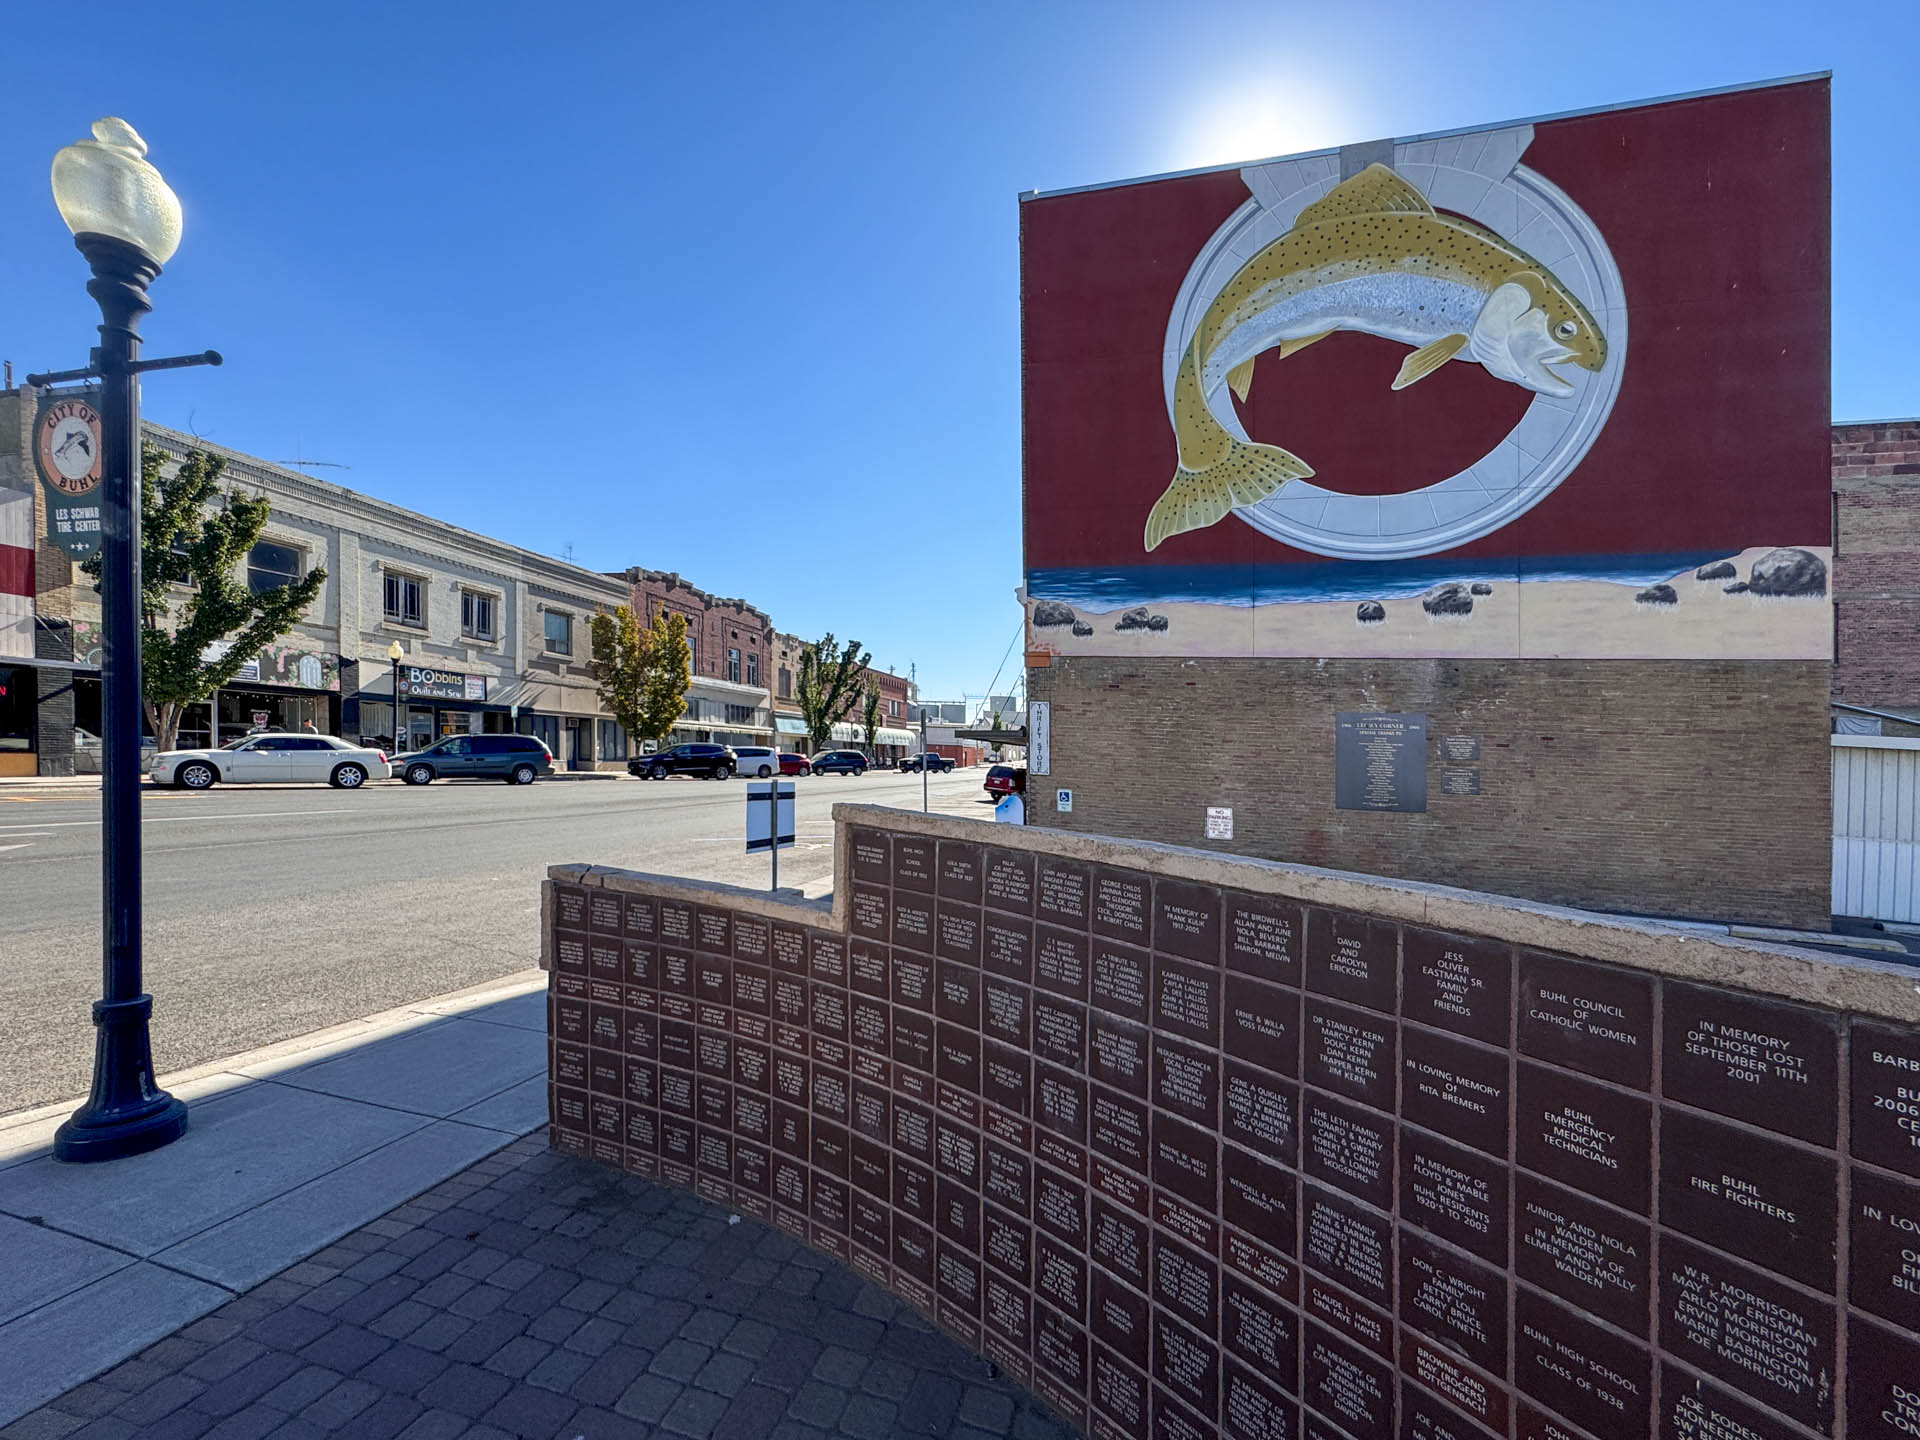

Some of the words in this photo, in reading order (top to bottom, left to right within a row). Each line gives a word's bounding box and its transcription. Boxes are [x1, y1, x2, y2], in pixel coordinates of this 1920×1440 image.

[48, 404, 75, 428] CITY
[78, 407, 97, 425] OF
[59, 474, 98, 492] BUHL
[56, 508, 68, 520] LES
[71, 507, 100, 519] SCHWAB
[56, 521, 72, 532] TIRE
[75, 520, 100, 532] CENTER
[1337, 937, 1361, 948] DAVID
[1340, 947, 1358, 957] AND
[1444, 951, 1463, 962] JESS
[1330, 962, 1367, 978] ERICKSON
[1331, 954, 1367, 969] CAROLYN
[1422, 966, 1466, 984] EASTMAN
[1437, 959, 1469, 974] OLIVER
[1436, 979, 1468, 994] FAMILY
[1442, 991, 1463, 1003] AND
[1433, 999, 1470, 1016] FRIENDS
[1540, 989, 1568, 1004] BUHL
[1573, 997, 1624, 1018] COUNCIL
[1573, 1009, 1588, 1019] OF
[1313, 1015, 1323, 1024] DR
[1326, 1019, 1359, 1035] STANLEY
[1362, 1030, 1383, 1043] KERN
[1321, 1027, 1349, 1041] MARCY
[1352, 1037, 1374, 1049] KERN
[1530, 1009, 1583, 1030] CATHOLIC
[1588, 1024, 1636, 1044] WOMEN
[1700, 1020, 1713, 1032] IN
[1721, 1025, 1789, 1050] MEMORY
[1324, 1037, 1346, 1050] DOUG
[1349, 1045, 1371, 1058] KERN
[1326, 1046, 1343, 1058] DAN
[1346, 1054, 1367, 1066] KERN
[1687, 1030, 1705, 1042] OF
[1711, 1036, 1757, 1056] THOSE
[1765, 1050, 1804, 1067] LOST
[1319, 1053, 1351, 1070] TRAPPER
[1355, 1065, 1376, 1079] KERN
[1328, 1066, 1341, 1076] JIM
[1344, 1070, 1365, 1085] KERN
[1685, 1042, 1767, 1072] SEPTEMBER
[1775, 1066, 1807, 1083] 11TH
[1727, 1066, 1759, 1084] 2001
[1406, 1059, 1415, 1068] IN
[1419, 1063, 1452, 1081] LOVING
[1456, 1076, 1500, 1096] MEMORY
[1419, 1083, 1438, 1096] RITA
[1442, 1091, 1485, 1113] BREMERS
[1544, 1111, 1615, 1143] EMERGENCY
[1564, 1107, 1594, 1125] BUHL
[1543, 1133, 1617, 1168] TECHNICIANS
[1553, 1126, 1604, 1152] MEDICAL
[1413, 1163, 1441, 1181] FLOYD
[1456, 1182, 1488, 1202] MABLE
[1415, 1154, 1424, 1164] IN
[1428, 1159, 1470, 1182] MEMORY
[1474, 1179, 1487, 1189] OF
[1722, 1174, 1760, 1197] BUHL
[1413, 1183, 1436, 1200] BUHL
[1440, 1194, 1489, 1223] RESIDENTS
[1691, 1176, 1718, 1194] FIRE
[1725, 1189, 1795, 1222] FIGHTERS
[1447, 1208, 1460, 1219] TO
[1464, 1215, 1487, 1232] 2003
[1526, 1202, 1564, 1225] JUNIOR
[1569, 1221, 1595, 1238] AND
[1601, 1234, 1636, 1256] NOLA
[1535, 1227, 1545, 1239] IN
[1551, 1234, 1603, 1264] MEMORY
[1608, 1261, 1624, 1274] OF
[1555, 1225, 1602, 1254] WALDEN
[1524, 1234, 1559, 1256] ELMER
[1564, 1253, 1590, 1270] AND
[1595, 1266, 1636, 1291] MOLLY
[1554, 1259, 1602, 1288] WALDEN
[1312, 1288, 1342, 1310] CLAUDE
[1355, 1312, 1380, 1332] HAYES
[1672, 1272, 1703, 1292] MAY
[1709, 1289, 1739, 1309] KAY
[1746, 1306, 1816, 1346] ERISMAN
[1684, 1265, 1713, 1285] W.R.
[1720, 1281, 1803, 1326] MORRISON
[1313, 1297, 1330, 1312] UNA
[1333, 1308, 1350, 1324] FAYE
[1354, 1321, 1380, 1341] HAYES
[1680, 1290, 1718, 1312] ARLO
[1724, 1309, 1807, 1356] MORRISON
[1674, 1310, 1717, 1339] MARIE
[1725, 1335, 1813, 1387] BABINGTON
[1678, 1300, 1718, 1327] ERVIN
[1726, 1322, 1808, 1371] MORRISON
[1417, 1347, 1458, 1378] BROWNIE
[1462, 1376, 1484, 1392] AND
[1523, 1324, 1552, 1347] BUHL
[1556, 1342, 1583, 1364] HIGH
[1589, 1360, 1638, 1394] SCHOOL
[1686, 1330, 1710, 1349] JOE
[1717, 1344, 1799, 1393] MORRISON
[1417, 1356, 1437, 1373] MAY
[1441, 1371, 1486, 1405] (ROGERS)
[1418, 1367, 1485, 1414] BOTTGENBACH
[1536, 1355, 1571, 1380] CLASS
[1576, 1377, 1591, 1390] OF
[1596, 1388, 1623, 1409] 1938
